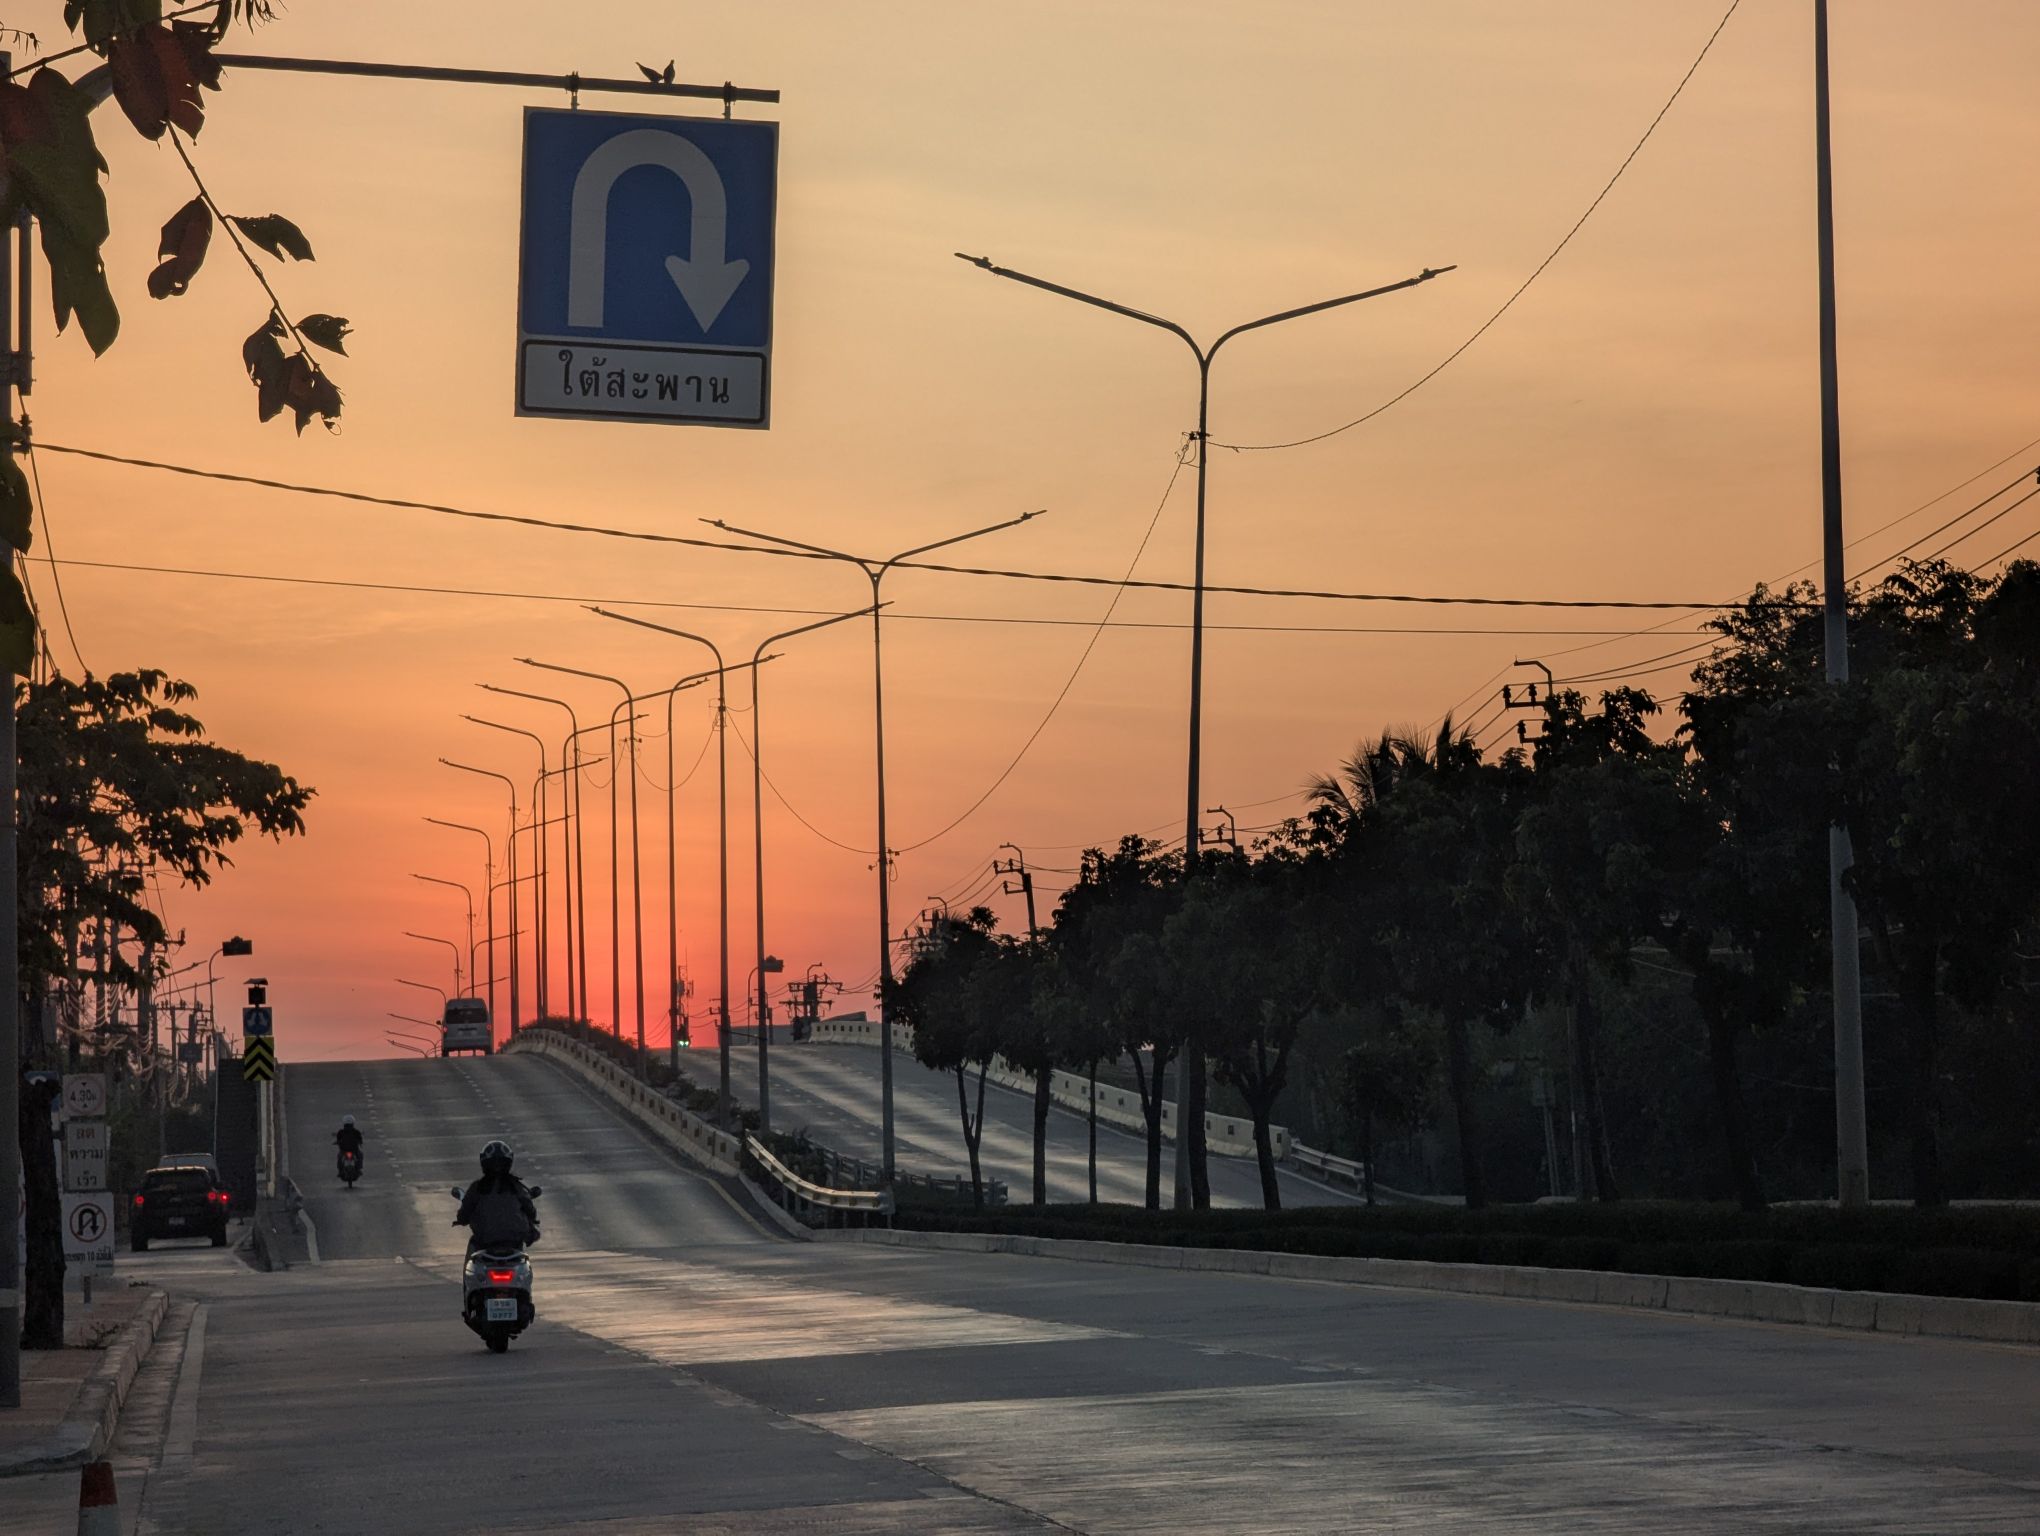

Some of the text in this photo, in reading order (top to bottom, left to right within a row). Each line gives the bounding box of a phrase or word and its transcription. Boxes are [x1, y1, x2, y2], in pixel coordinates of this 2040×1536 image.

[558, 349, 730, 404] ใต้สะพาน
[70, 1149, 104, 1161] ความ
[77, 1169, 97, 1186] เร็ว
